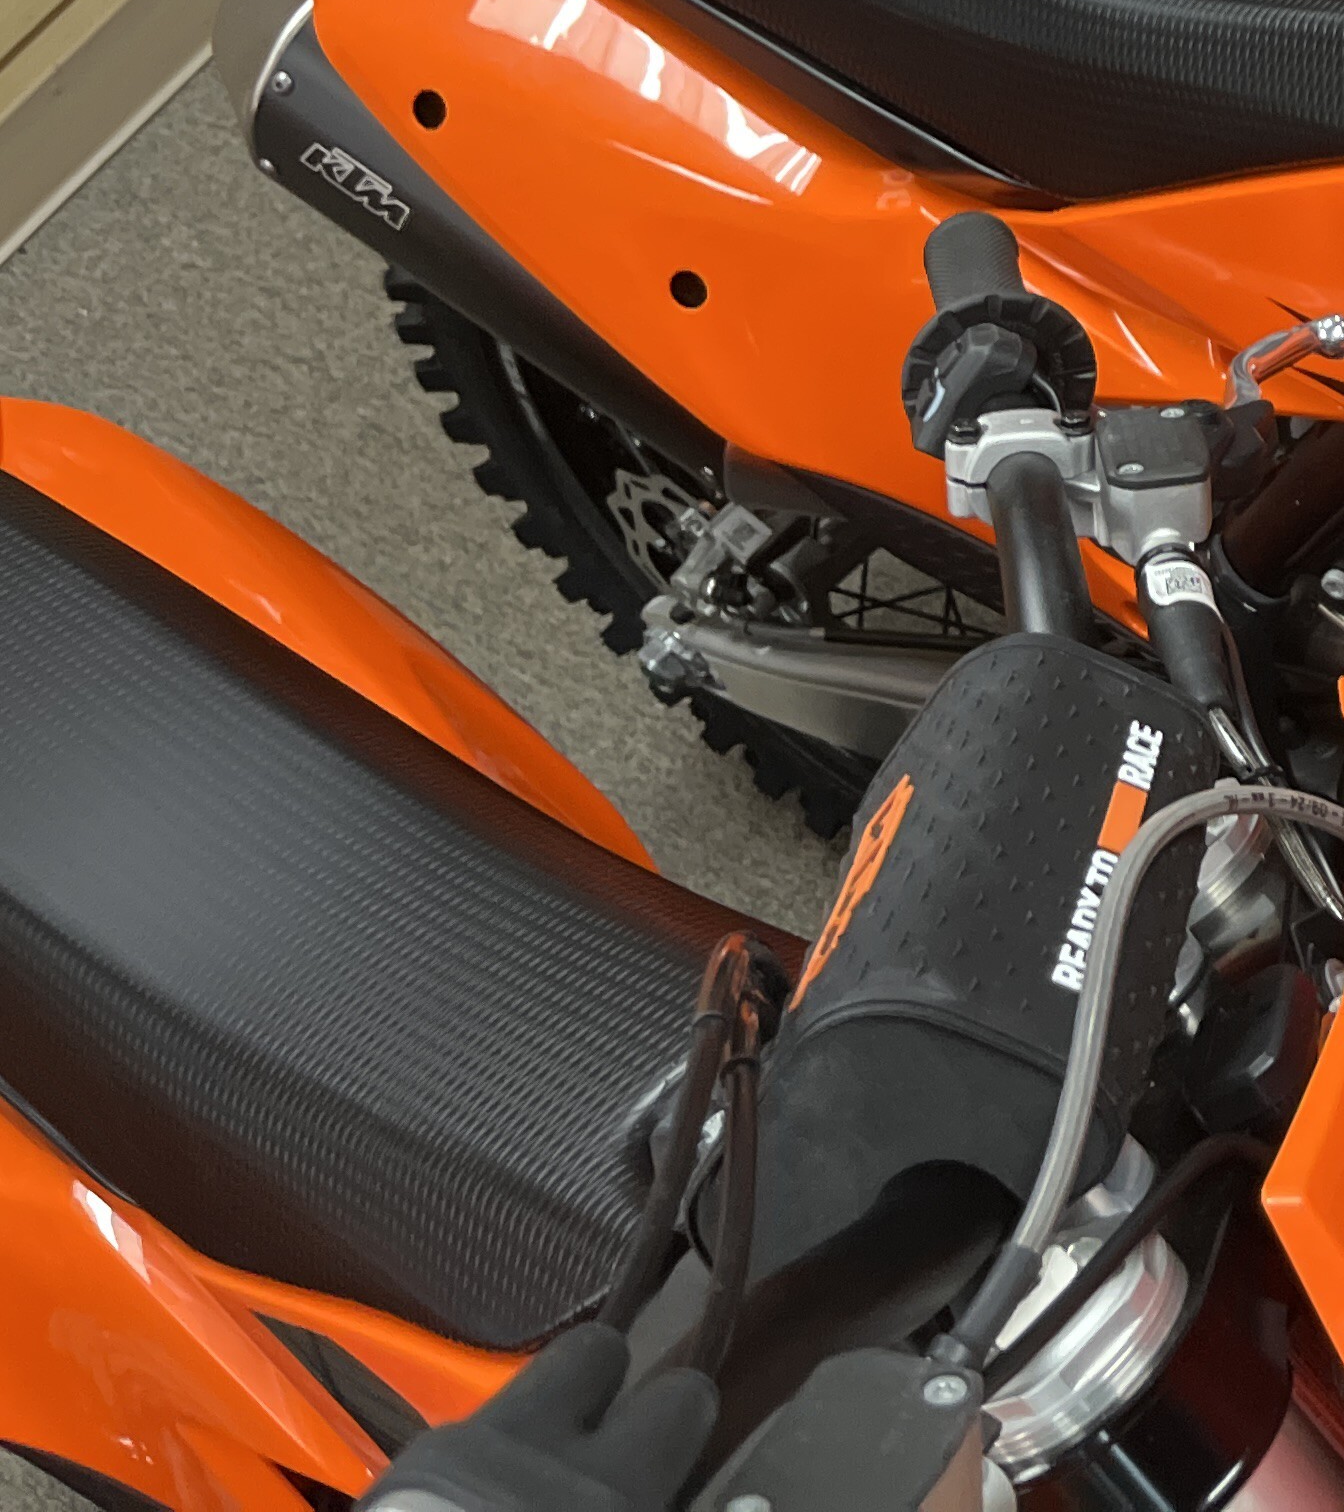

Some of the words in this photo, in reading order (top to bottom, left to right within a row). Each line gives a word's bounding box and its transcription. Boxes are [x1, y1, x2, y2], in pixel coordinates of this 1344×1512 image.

[301, 142, 411, 232] KTM
[1050, 884, 1102, 992] READY
[1084, 848, 1119, 889] TO
[1116, 719, 1164, 791] RACE
